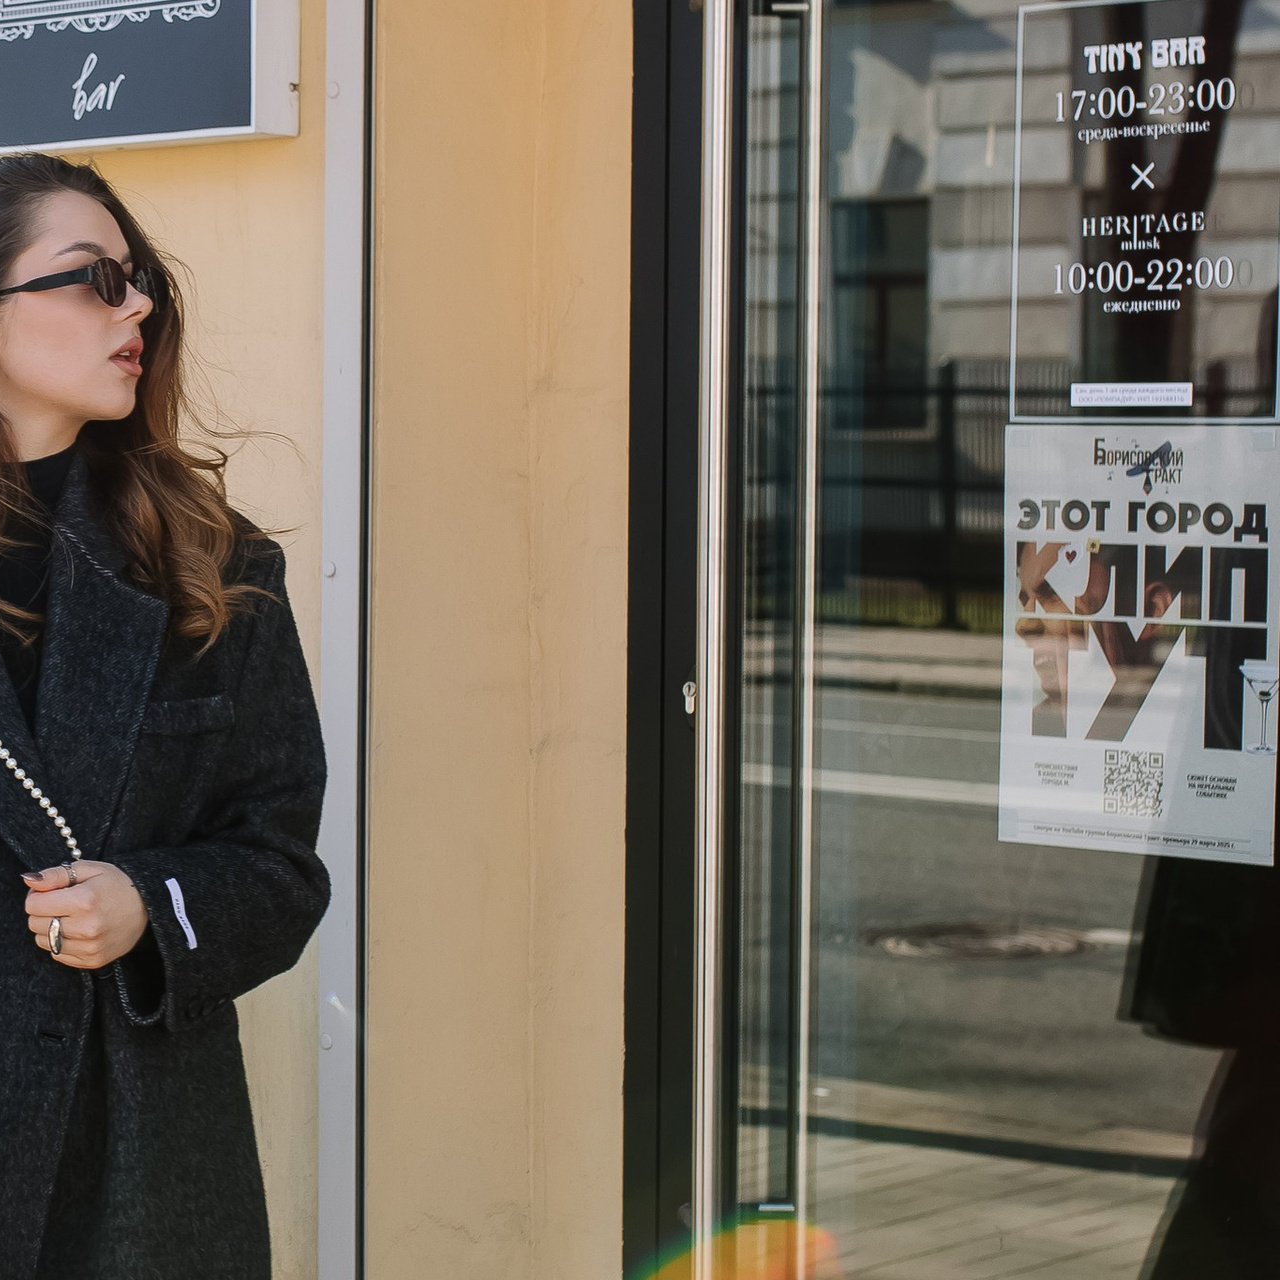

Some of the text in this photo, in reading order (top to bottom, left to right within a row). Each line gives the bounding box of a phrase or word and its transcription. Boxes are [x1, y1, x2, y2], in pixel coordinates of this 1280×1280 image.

[1083, 35, 1206, 74] TINY BAR
[70, 52, 126, 121] bar
[1055, 77, 1236, 123] 17:00-23:00
[1077, 120, 1211, 145] среда-воскресенье
[1082, 211, 1206, 244] HERITAGE
[1053, 255, 1234, 295] 10:00-22:00
[1102, 299, 1181, 314] ежедневно
[1016, 499, 1269, 543] ЭТОТ ГОРОД
[1015, 541, 1269, 623] КЛИП
[1014, 619, 1269, 751] ТУТ
